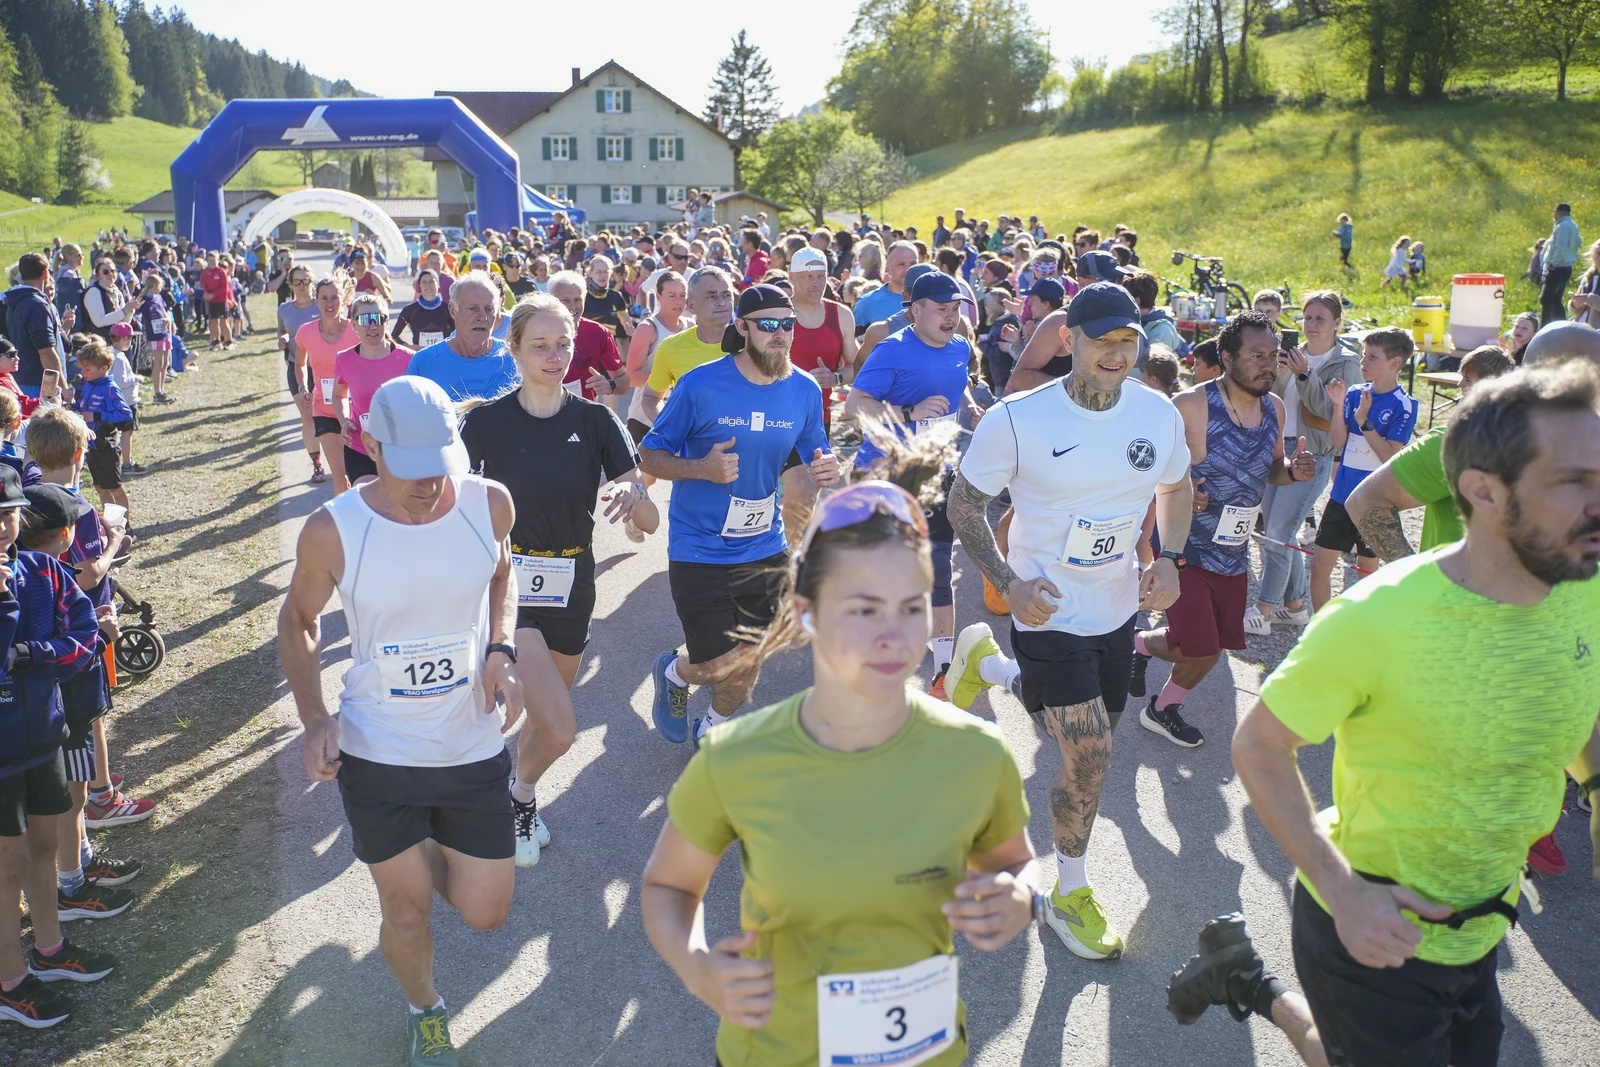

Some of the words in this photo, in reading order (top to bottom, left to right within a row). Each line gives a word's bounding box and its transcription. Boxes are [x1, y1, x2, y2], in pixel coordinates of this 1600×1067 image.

[349, 133, 419, 141] www.sv-mg.de
[718, 416, 750, 427] allgäu
[766, 420, 792, 429] outlet
[744, 512, 764, 526] 27
[1234, 520, 1250, 534] 53
[1091, 536, 1116, 556] 50
[531, 574, 544, 592] 9
[402, 641, 460, 656] Allgäu-Oberschwaben
[404, 658, 454, 686] 123
[884, 1006, 908, 1042] 3
